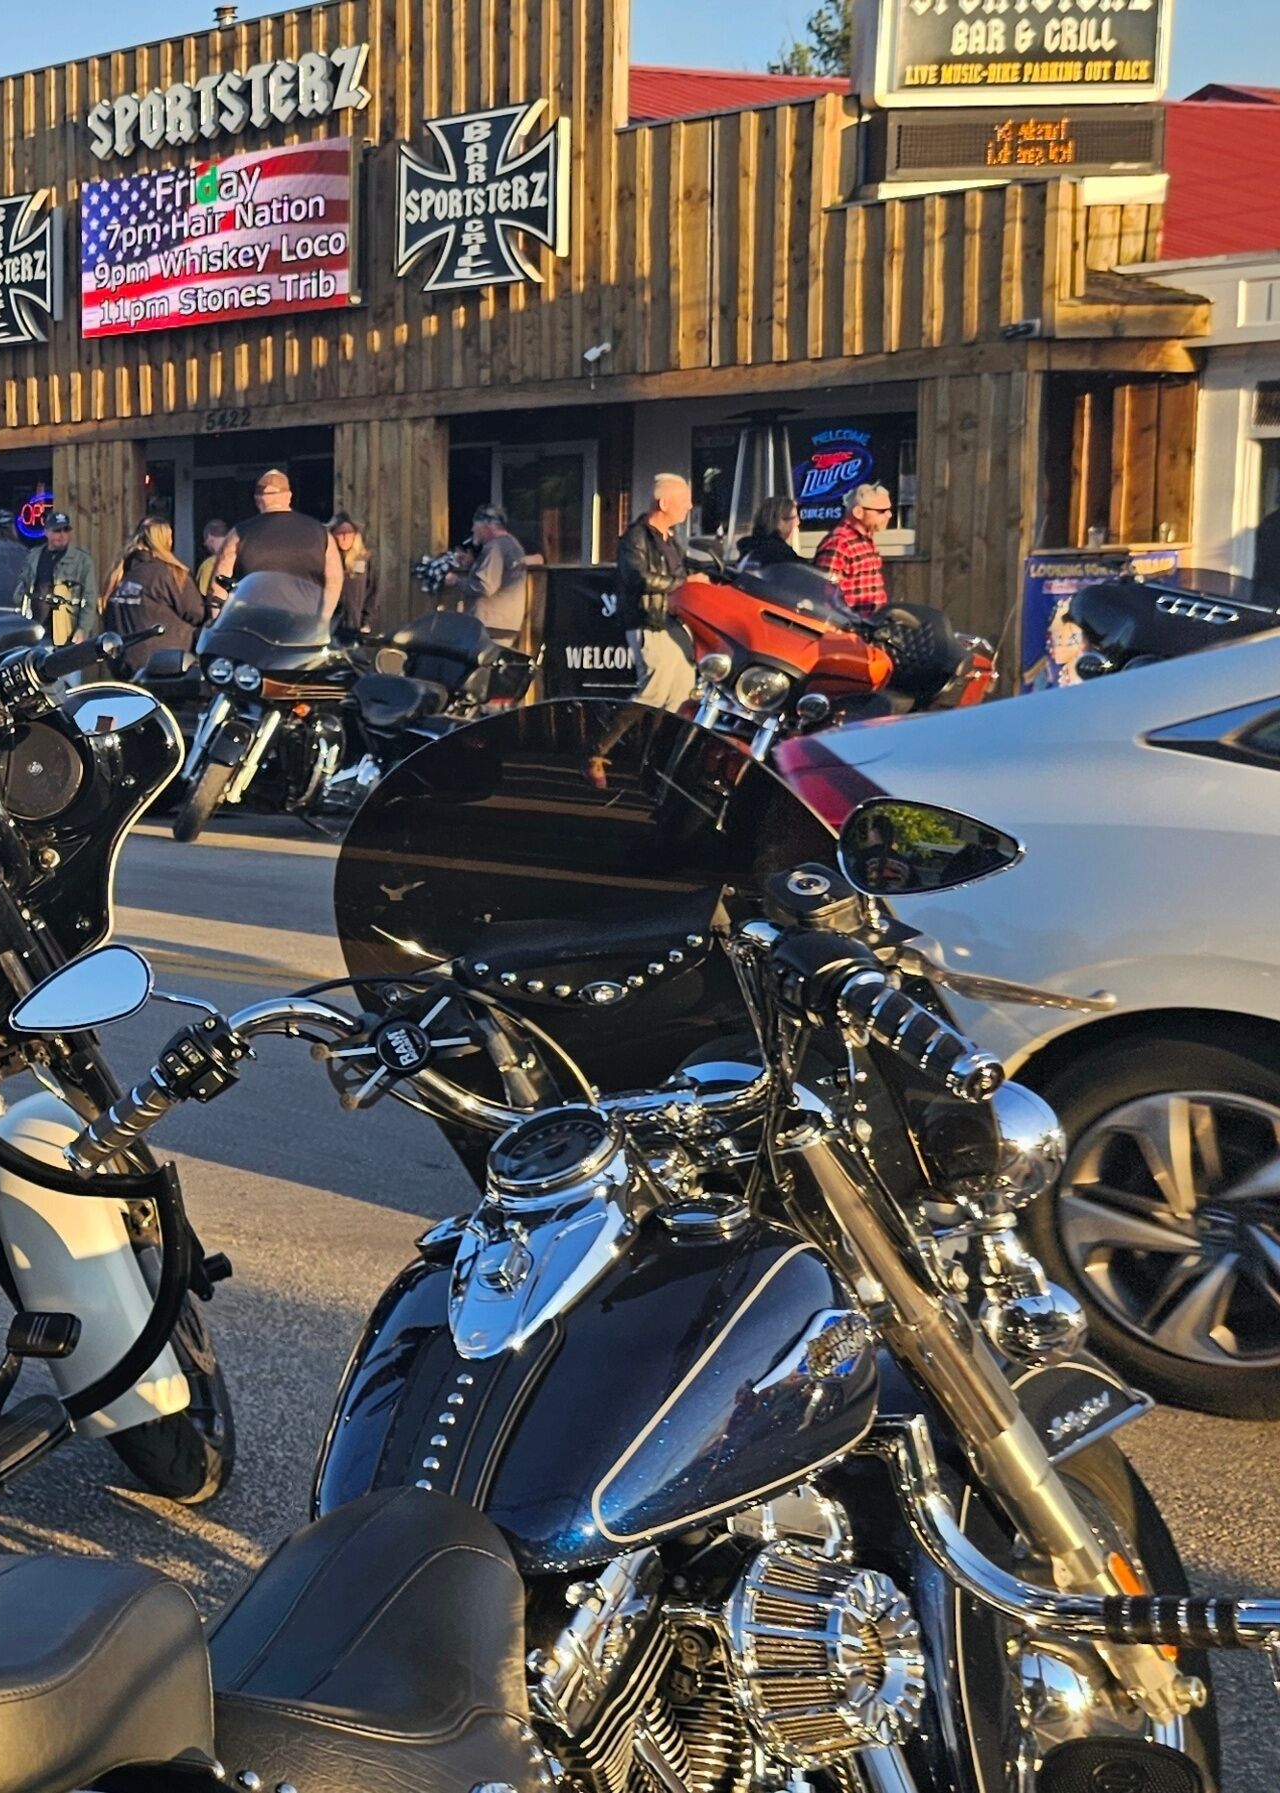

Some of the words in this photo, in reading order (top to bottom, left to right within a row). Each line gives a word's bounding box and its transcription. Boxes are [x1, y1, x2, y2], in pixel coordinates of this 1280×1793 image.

[950, 19, 1006, 55] BAR
[1014, 18, 1037, 54] &
[1044, 17, 1118, 53] GRILL
[904, 64, 938, 86] LIVE
[1023, 60, 1083, 83] PARKING
[1084, 60, 1114, 82] OUT
[1114, 60, 1150, 81] BACK
[88, 44, 370, 160] SPORTSTERZ
[462, 121, 491, 184] BAR
[156, 165, 262, 210] Friday
[405, 171, 548, 225] SPORTSTERZ
[106, 222, 161, 251] 7pm
[172, 206, 225, 239] Hair
[235, 194, 325, 230] Nation
[94, 258, 150, 292] 9pm
[159, 242, 270, 280] Whiskey
[281, 231, 347, 263] Loco
[454, 219, 495, 279] GRILL
[100, 295, 169, 327] 11pm
[178, 281, 271, 316] Stones
[280, 269, 336, 302] Trib
[22, 502, 54, 527] OP
[1029, 563, 1084, 578] LOOKING
[565, 645, 636, 670] WELCO
[386, 1029, 419, 1066] RAM
